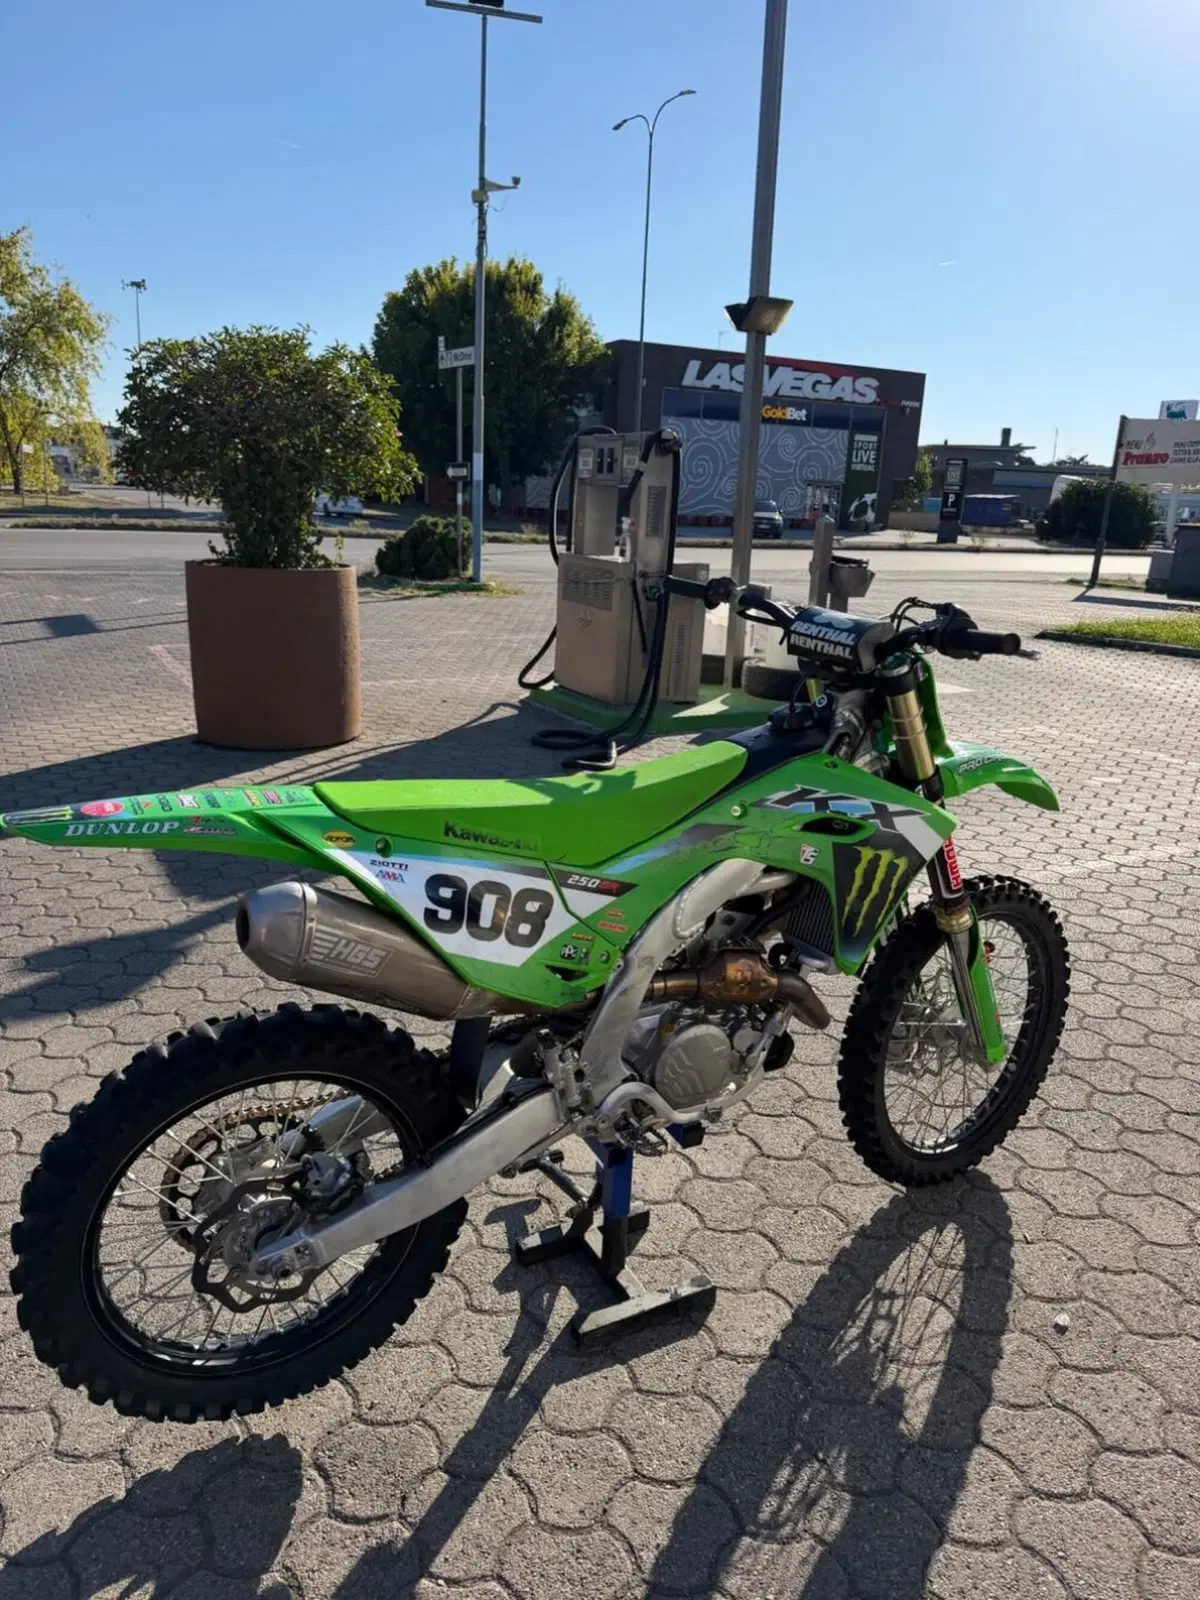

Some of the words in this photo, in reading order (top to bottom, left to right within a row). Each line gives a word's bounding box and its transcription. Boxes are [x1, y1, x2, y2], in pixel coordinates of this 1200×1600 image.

[762, 364, 880, 404] VEGAS
[762, 405, 807, 421] GoldBet
[854, 441, 877, 449] SPORT
[852, 450, 876, 463] LIVE
[790, 621, 857, 645] RENTHAL
[790, 633, 853, 660] RENTHAL
[65, 821, 179, 837] DUNLOP
[370, 859, 408, 871] ZIOTTI
[424, 874, 554, 948] 908
[330, 939, 386, 968] HGS
